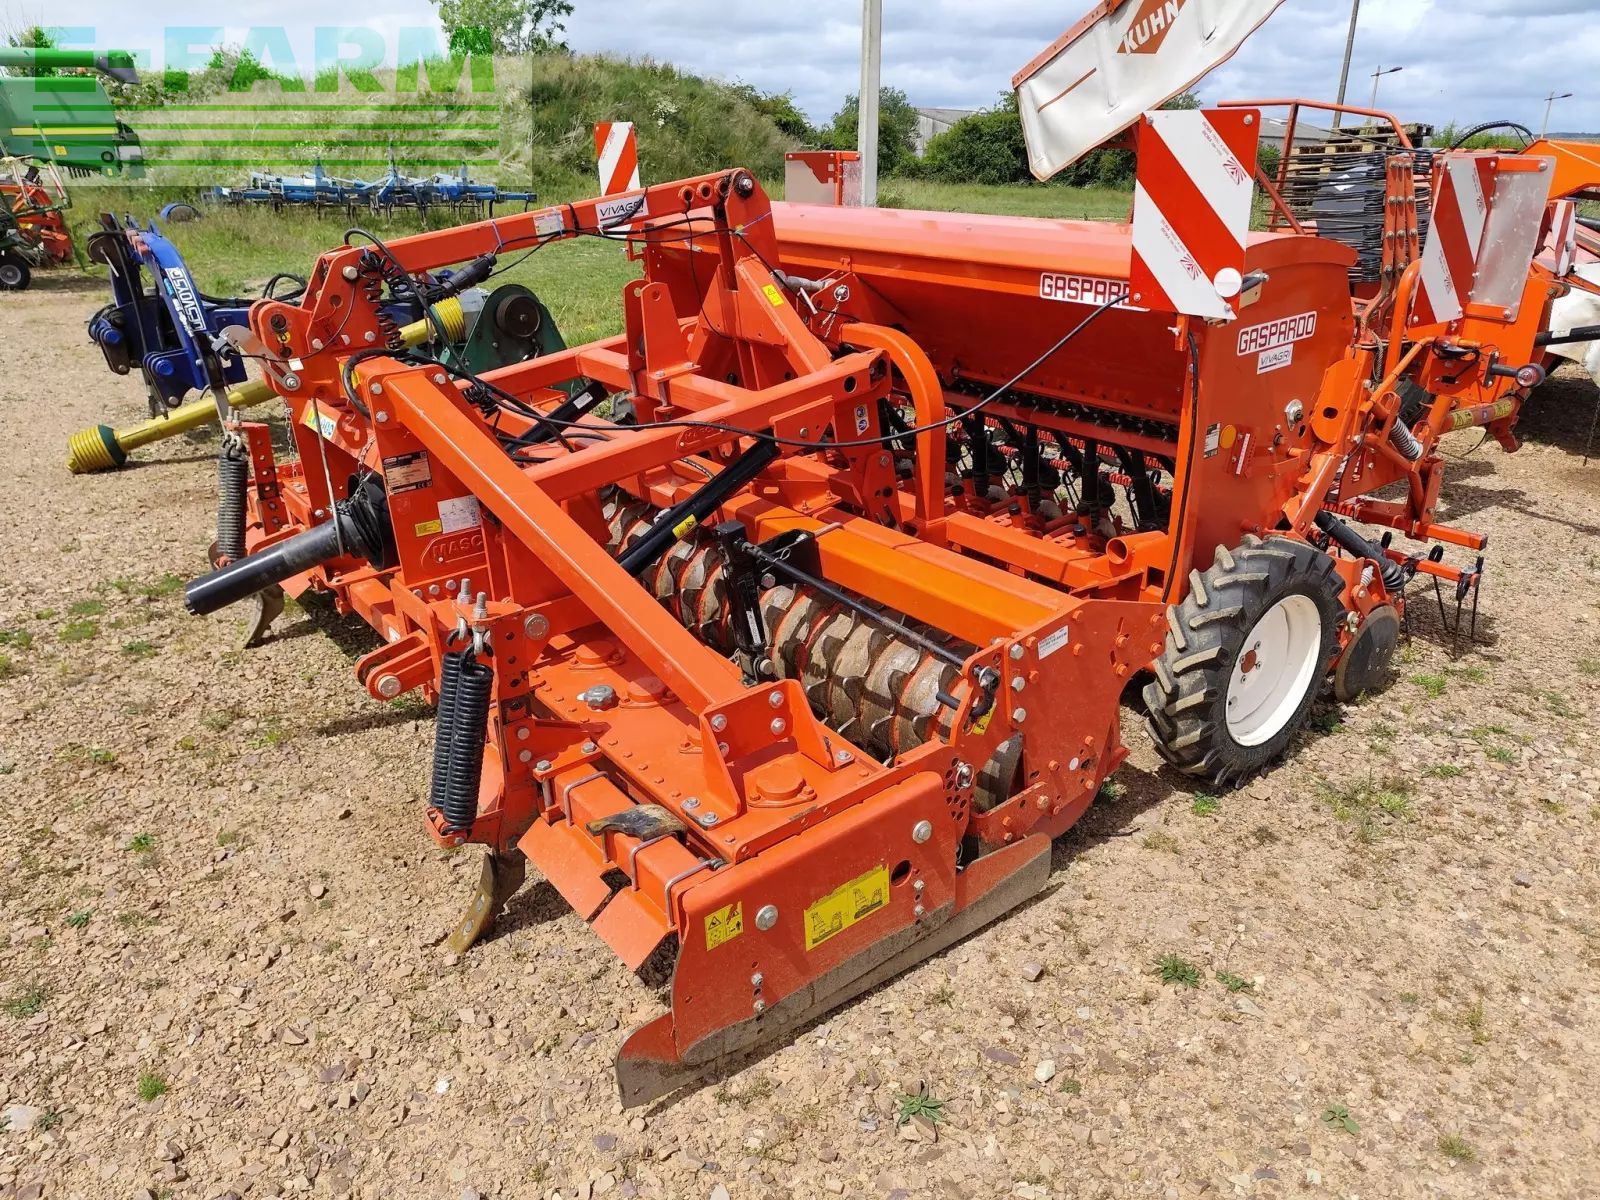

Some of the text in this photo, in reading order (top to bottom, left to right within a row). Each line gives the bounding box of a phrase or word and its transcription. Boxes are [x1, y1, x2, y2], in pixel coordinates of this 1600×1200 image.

[1123, 0, 1179, 55] KUHN
[1041, 274, 1130, 306] GASPARD
[1239, 313, 1316, 353] GASPARDO
